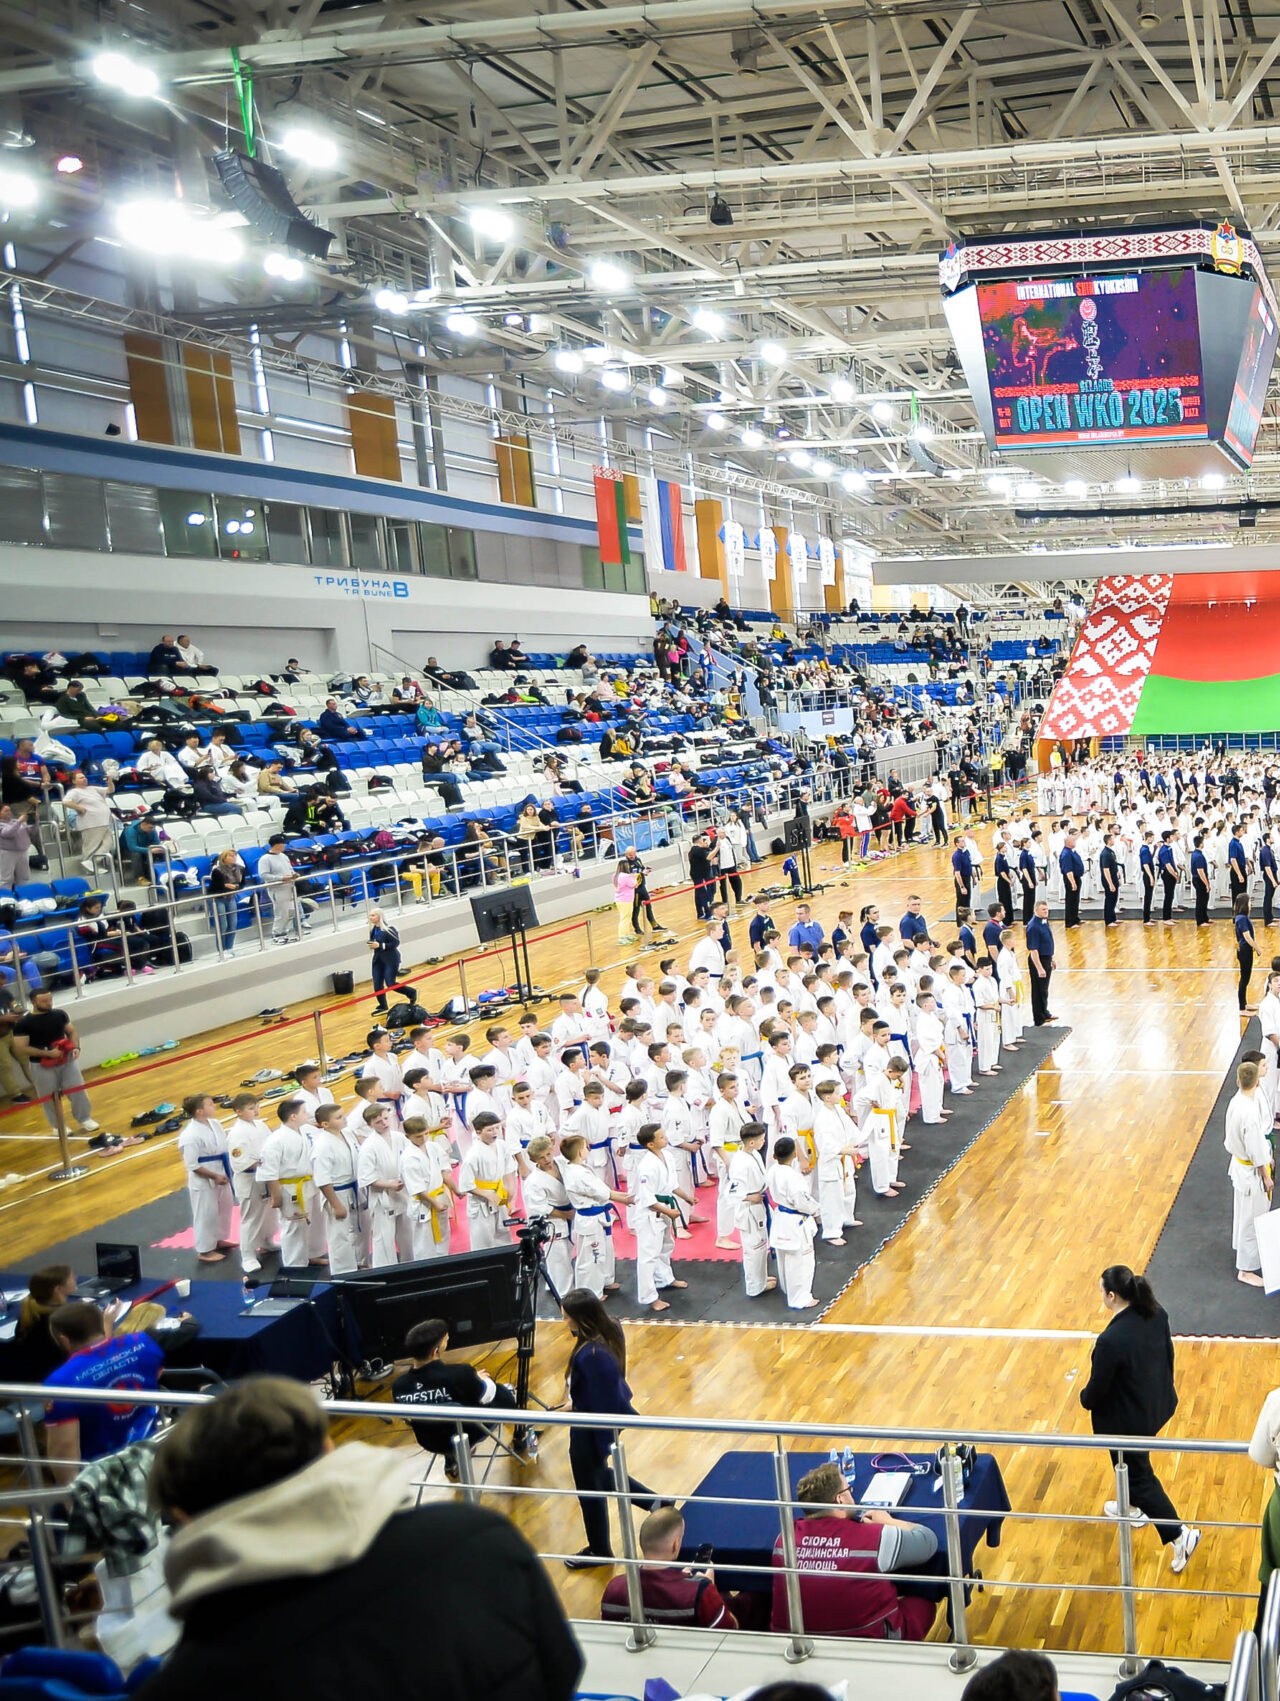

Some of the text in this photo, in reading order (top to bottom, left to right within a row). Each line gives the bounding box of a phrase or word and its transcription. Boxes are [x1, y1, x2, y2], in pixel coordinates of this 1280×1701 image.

[1017, 283, 1076, 300] INTERNATIONAL
[1017, 387, 1185, 432] OPEN WKO 2025
[314, 576, 391, 589] ТРИБУНА
[344, 588, 392, 597] TRBUNE
[75, 1342, 145, 1382] МОСКОВСКАЯ
[92, 1356, 138, 1381] ОБЛАСТЬ
[801, 1535, 841, 1547] СКОРАЯ
[796, 1547, 849, 1559] ЕДИЦИНСКАЯ
[797, 1560, 837, 1571] ПОМОЩЬ
